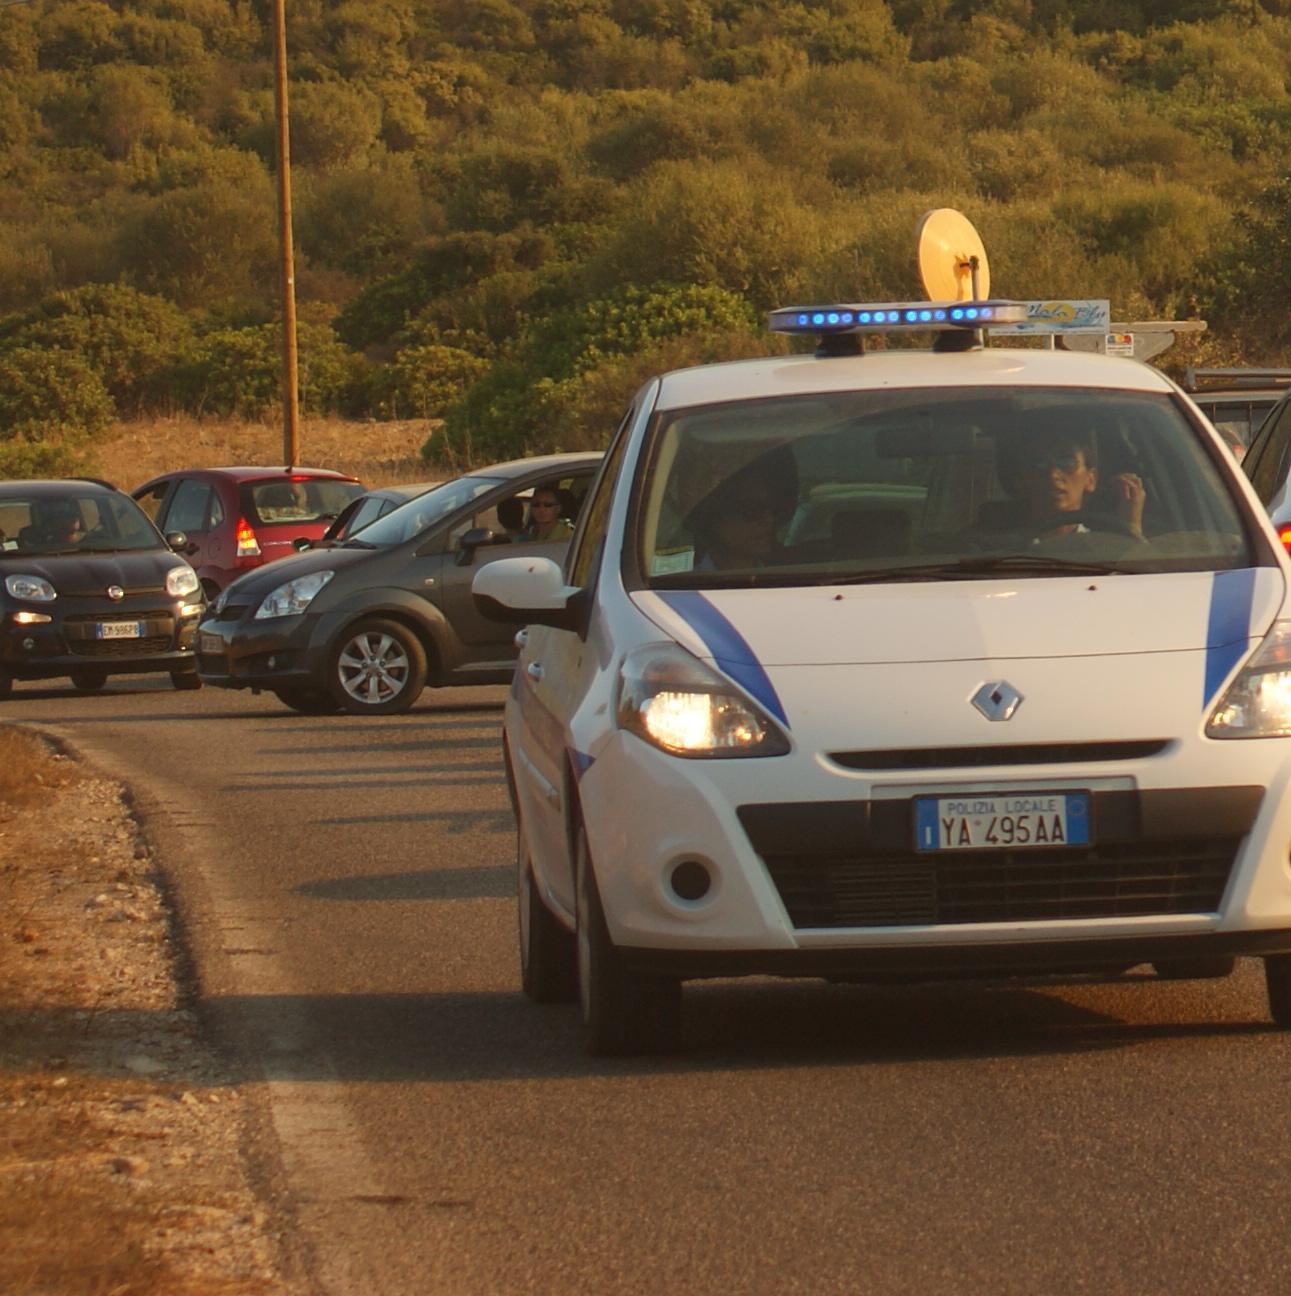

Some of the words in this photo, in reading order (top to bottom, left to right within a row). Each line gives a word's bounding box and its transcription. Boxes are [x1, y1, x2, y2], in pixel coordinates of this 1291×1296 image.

[948, 801, 996, 815] POLIZIA
[1005, 799, 1057, 813] LOCALE
[942, 818, 971, 846] YA
[985, 815, 1065, 844] 495AA
